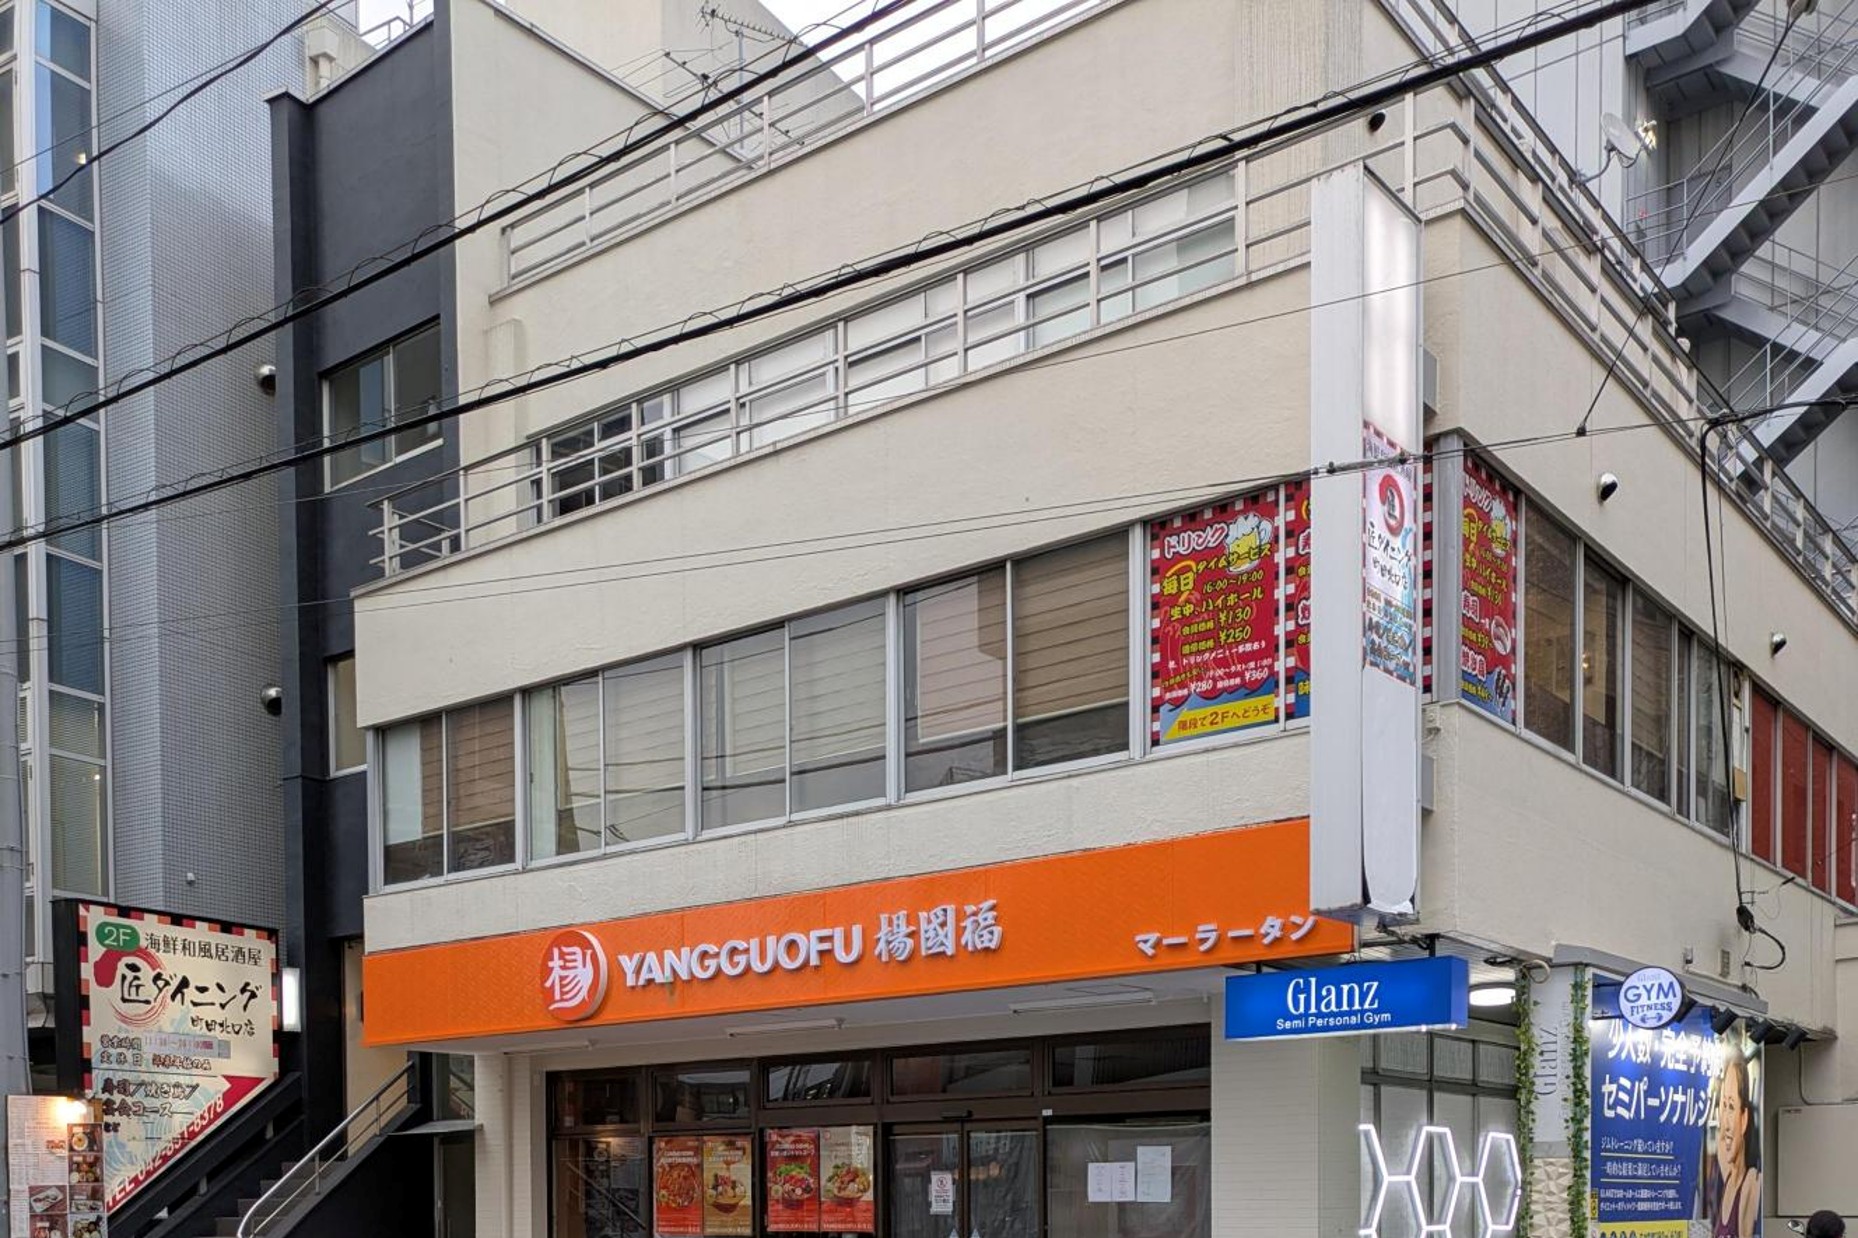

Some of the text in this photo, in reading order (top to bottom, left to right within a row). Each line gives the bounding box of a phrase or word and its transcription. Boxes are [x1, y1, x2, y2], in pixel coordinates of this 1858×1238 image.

[1164, 522, 1228, 558] ドリンク
[1196, 545, 1271, 575] タイムサービス
[1161, 571, 1195, 596] 毎日
[104, 926, 132, 947] 2F
[145, 932, 263, 967] 海鮮和風居酒屋
[1134, 914, 1318, 958] マーラータン
[617, 922, 863, 989] YANGGUOFU
[120, 962, 263, 1013] 匠ダイニング
[1287, 977, 1379, 1015] Glanz
[1624, 981, 1677, 1003] GYM
[1276, 1011, 1392, 1030] Semi Personal Gym
[1630, 1001, 1673, 1017] FITNESS
[1601, 1074, 1720, 1128] セミパーソナルジム
